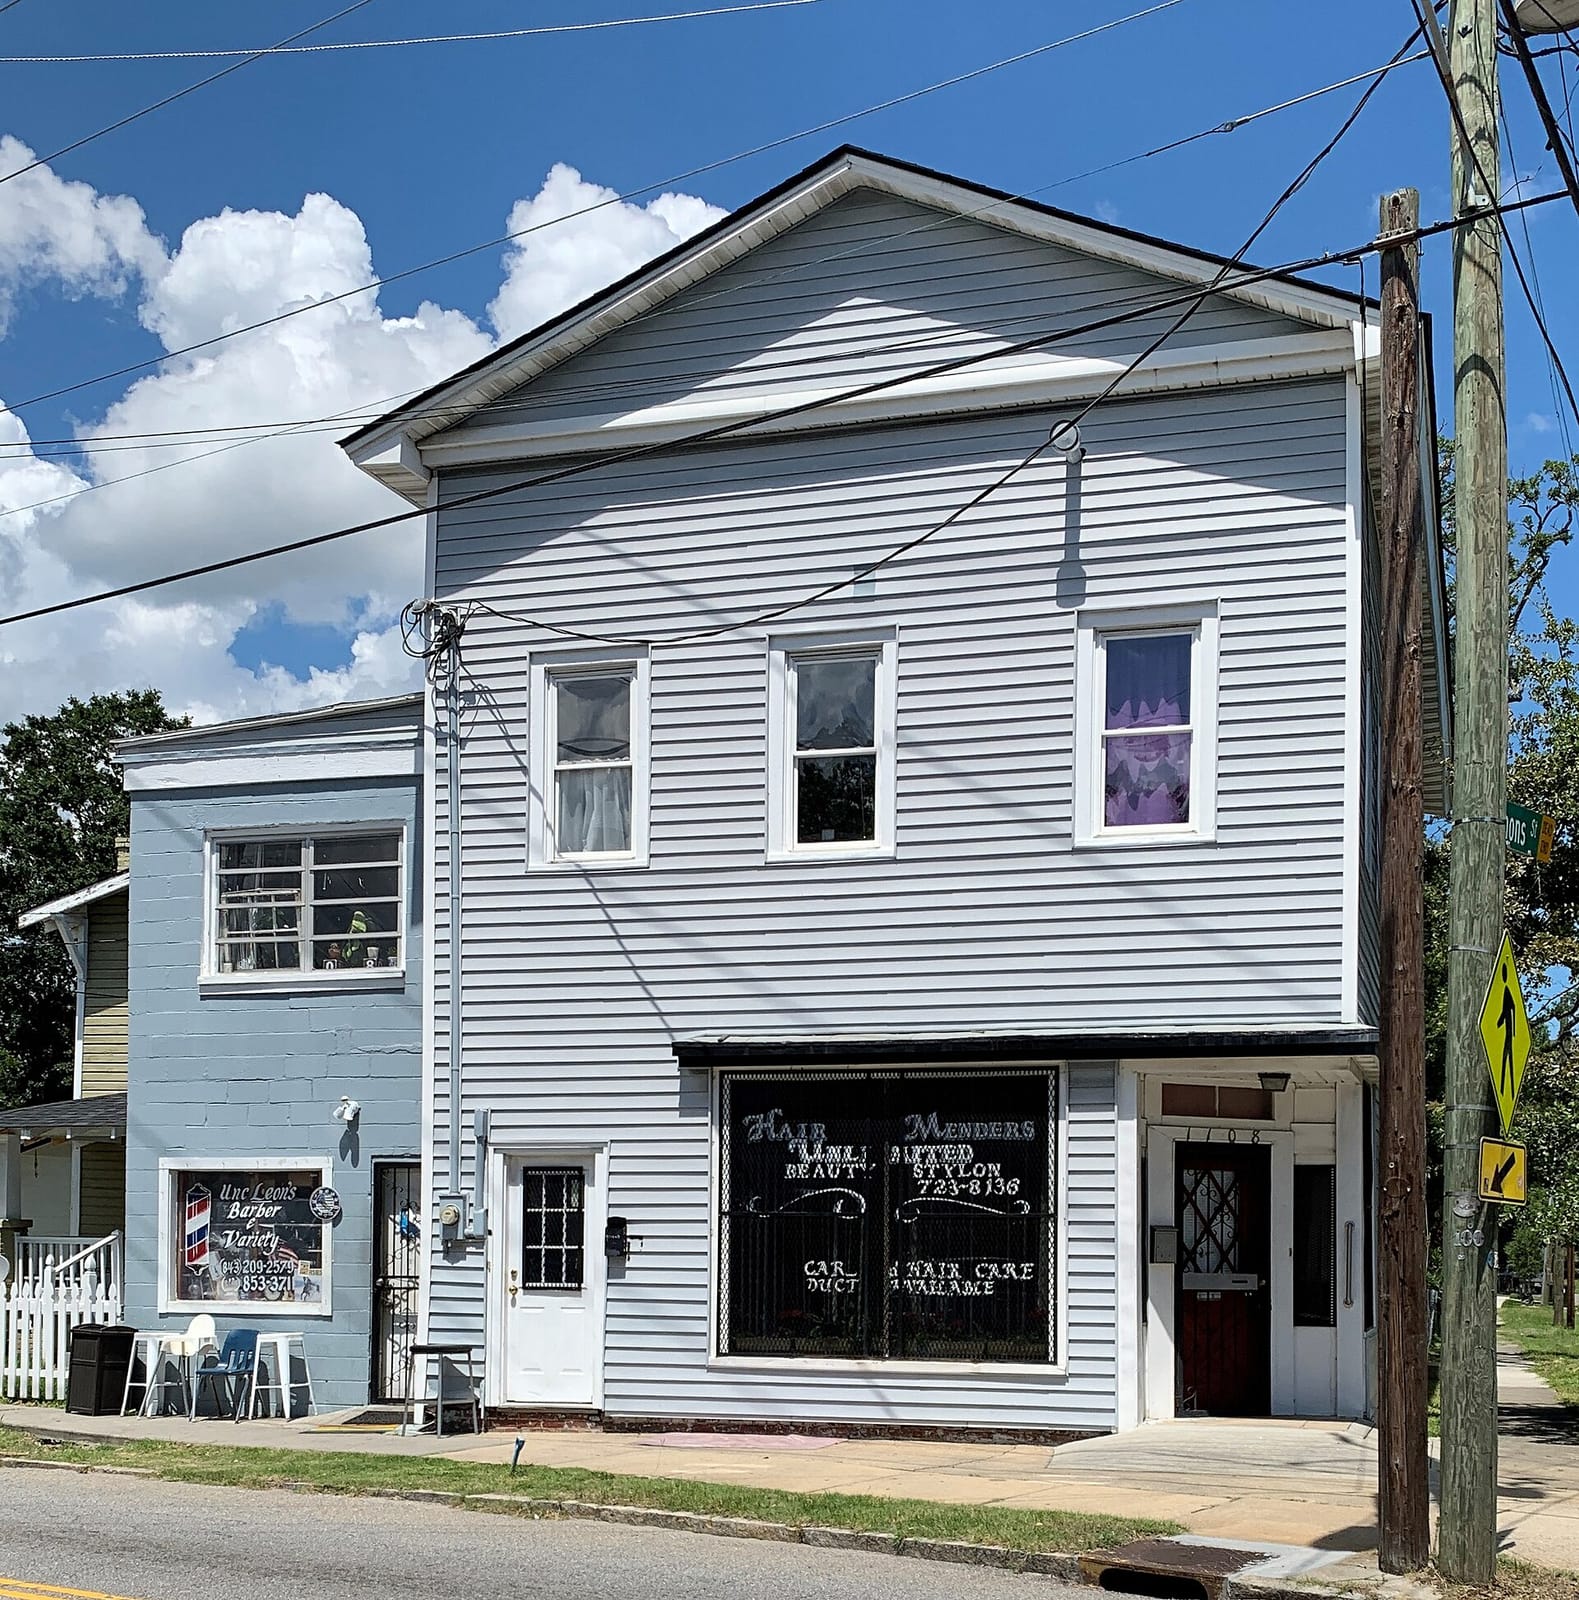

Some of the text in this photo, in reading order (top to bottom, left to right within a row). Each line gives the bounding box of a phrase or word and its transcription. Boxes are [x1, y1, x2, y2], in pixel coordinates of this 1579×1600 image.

[1186, 1127, 1261, 1144] 1108
[220, 1181, 298, 1202] Unc Leon's
[917, 1177, 1021, 1197] 723-8136
[226, 1201, 283, 1219] Barber
[222, 1229, 280, 1256] Variety
[974, 1262, 1035, 1280] CARE
